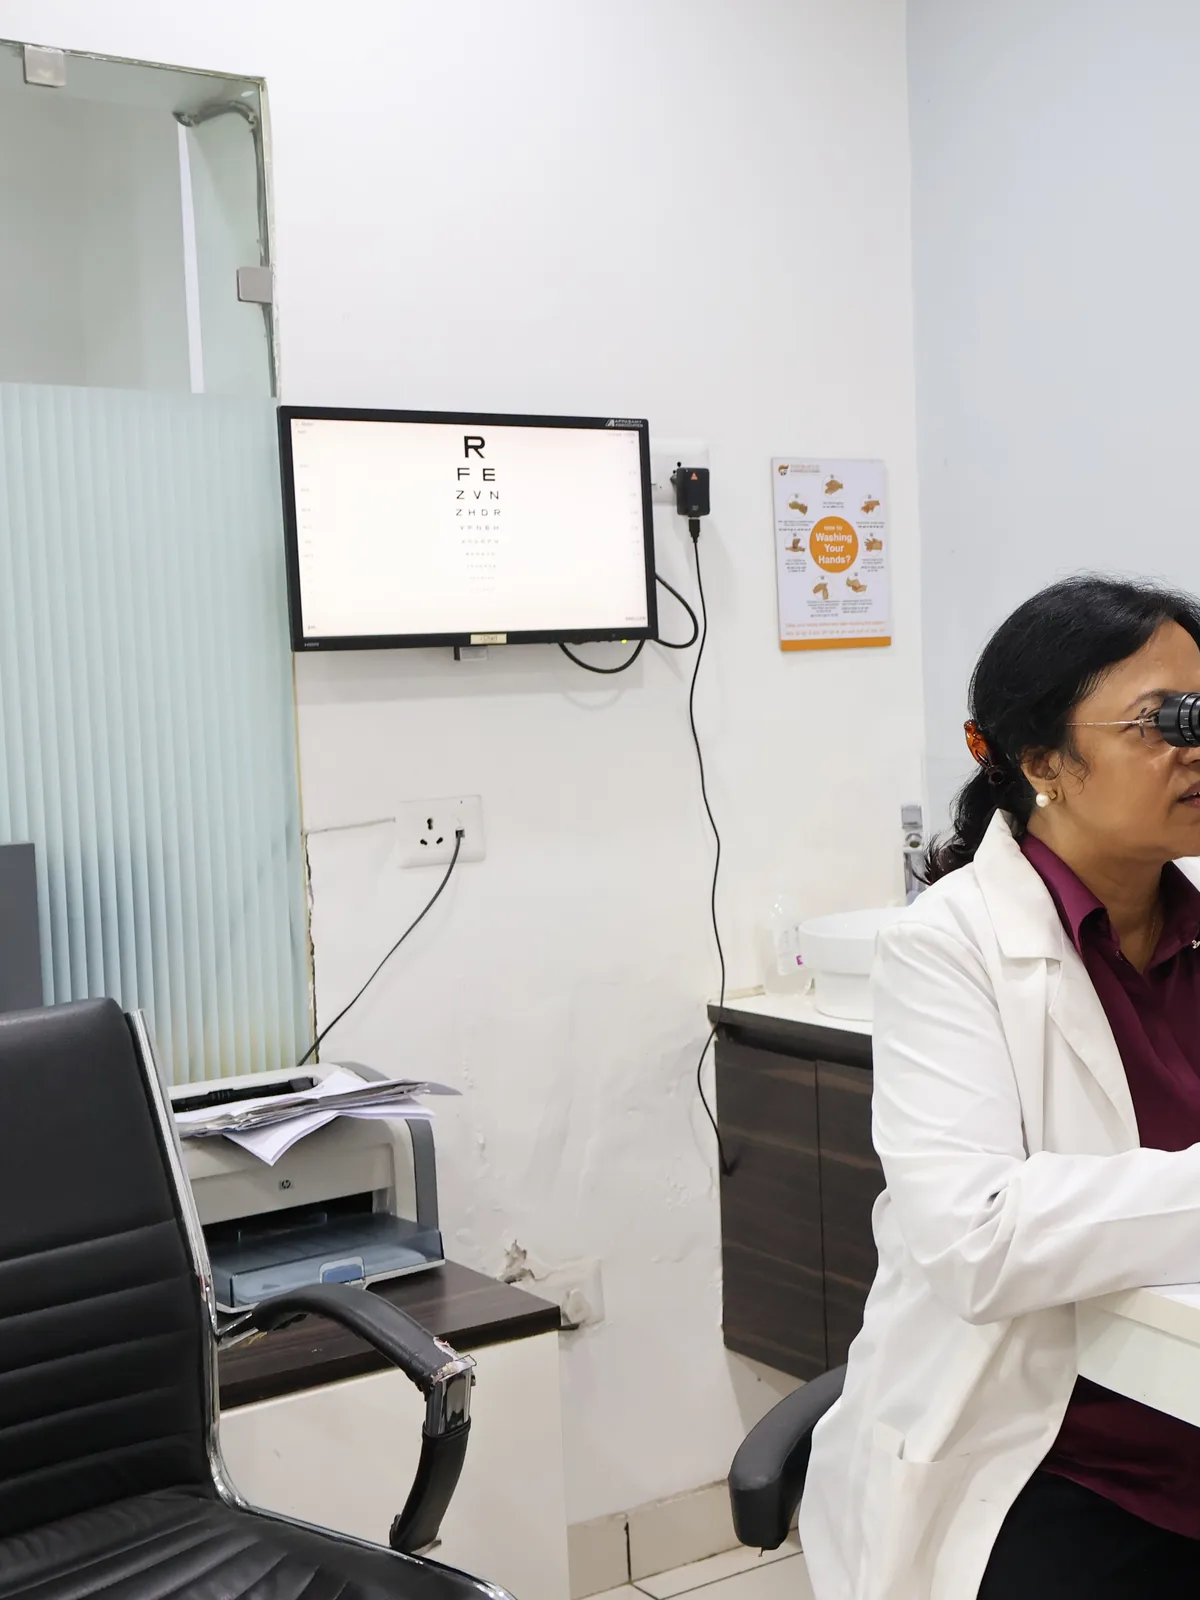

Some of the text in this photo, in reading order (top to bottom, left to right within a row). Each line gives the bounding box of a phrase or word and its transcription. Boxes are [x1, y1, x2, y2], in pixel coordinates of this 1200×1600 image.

[463, 435, 486, 459] R
[815, 532, 853, 544] Washing
[824, 543, 845, 553] Your
[818, 554, 851, 564] Hands?
